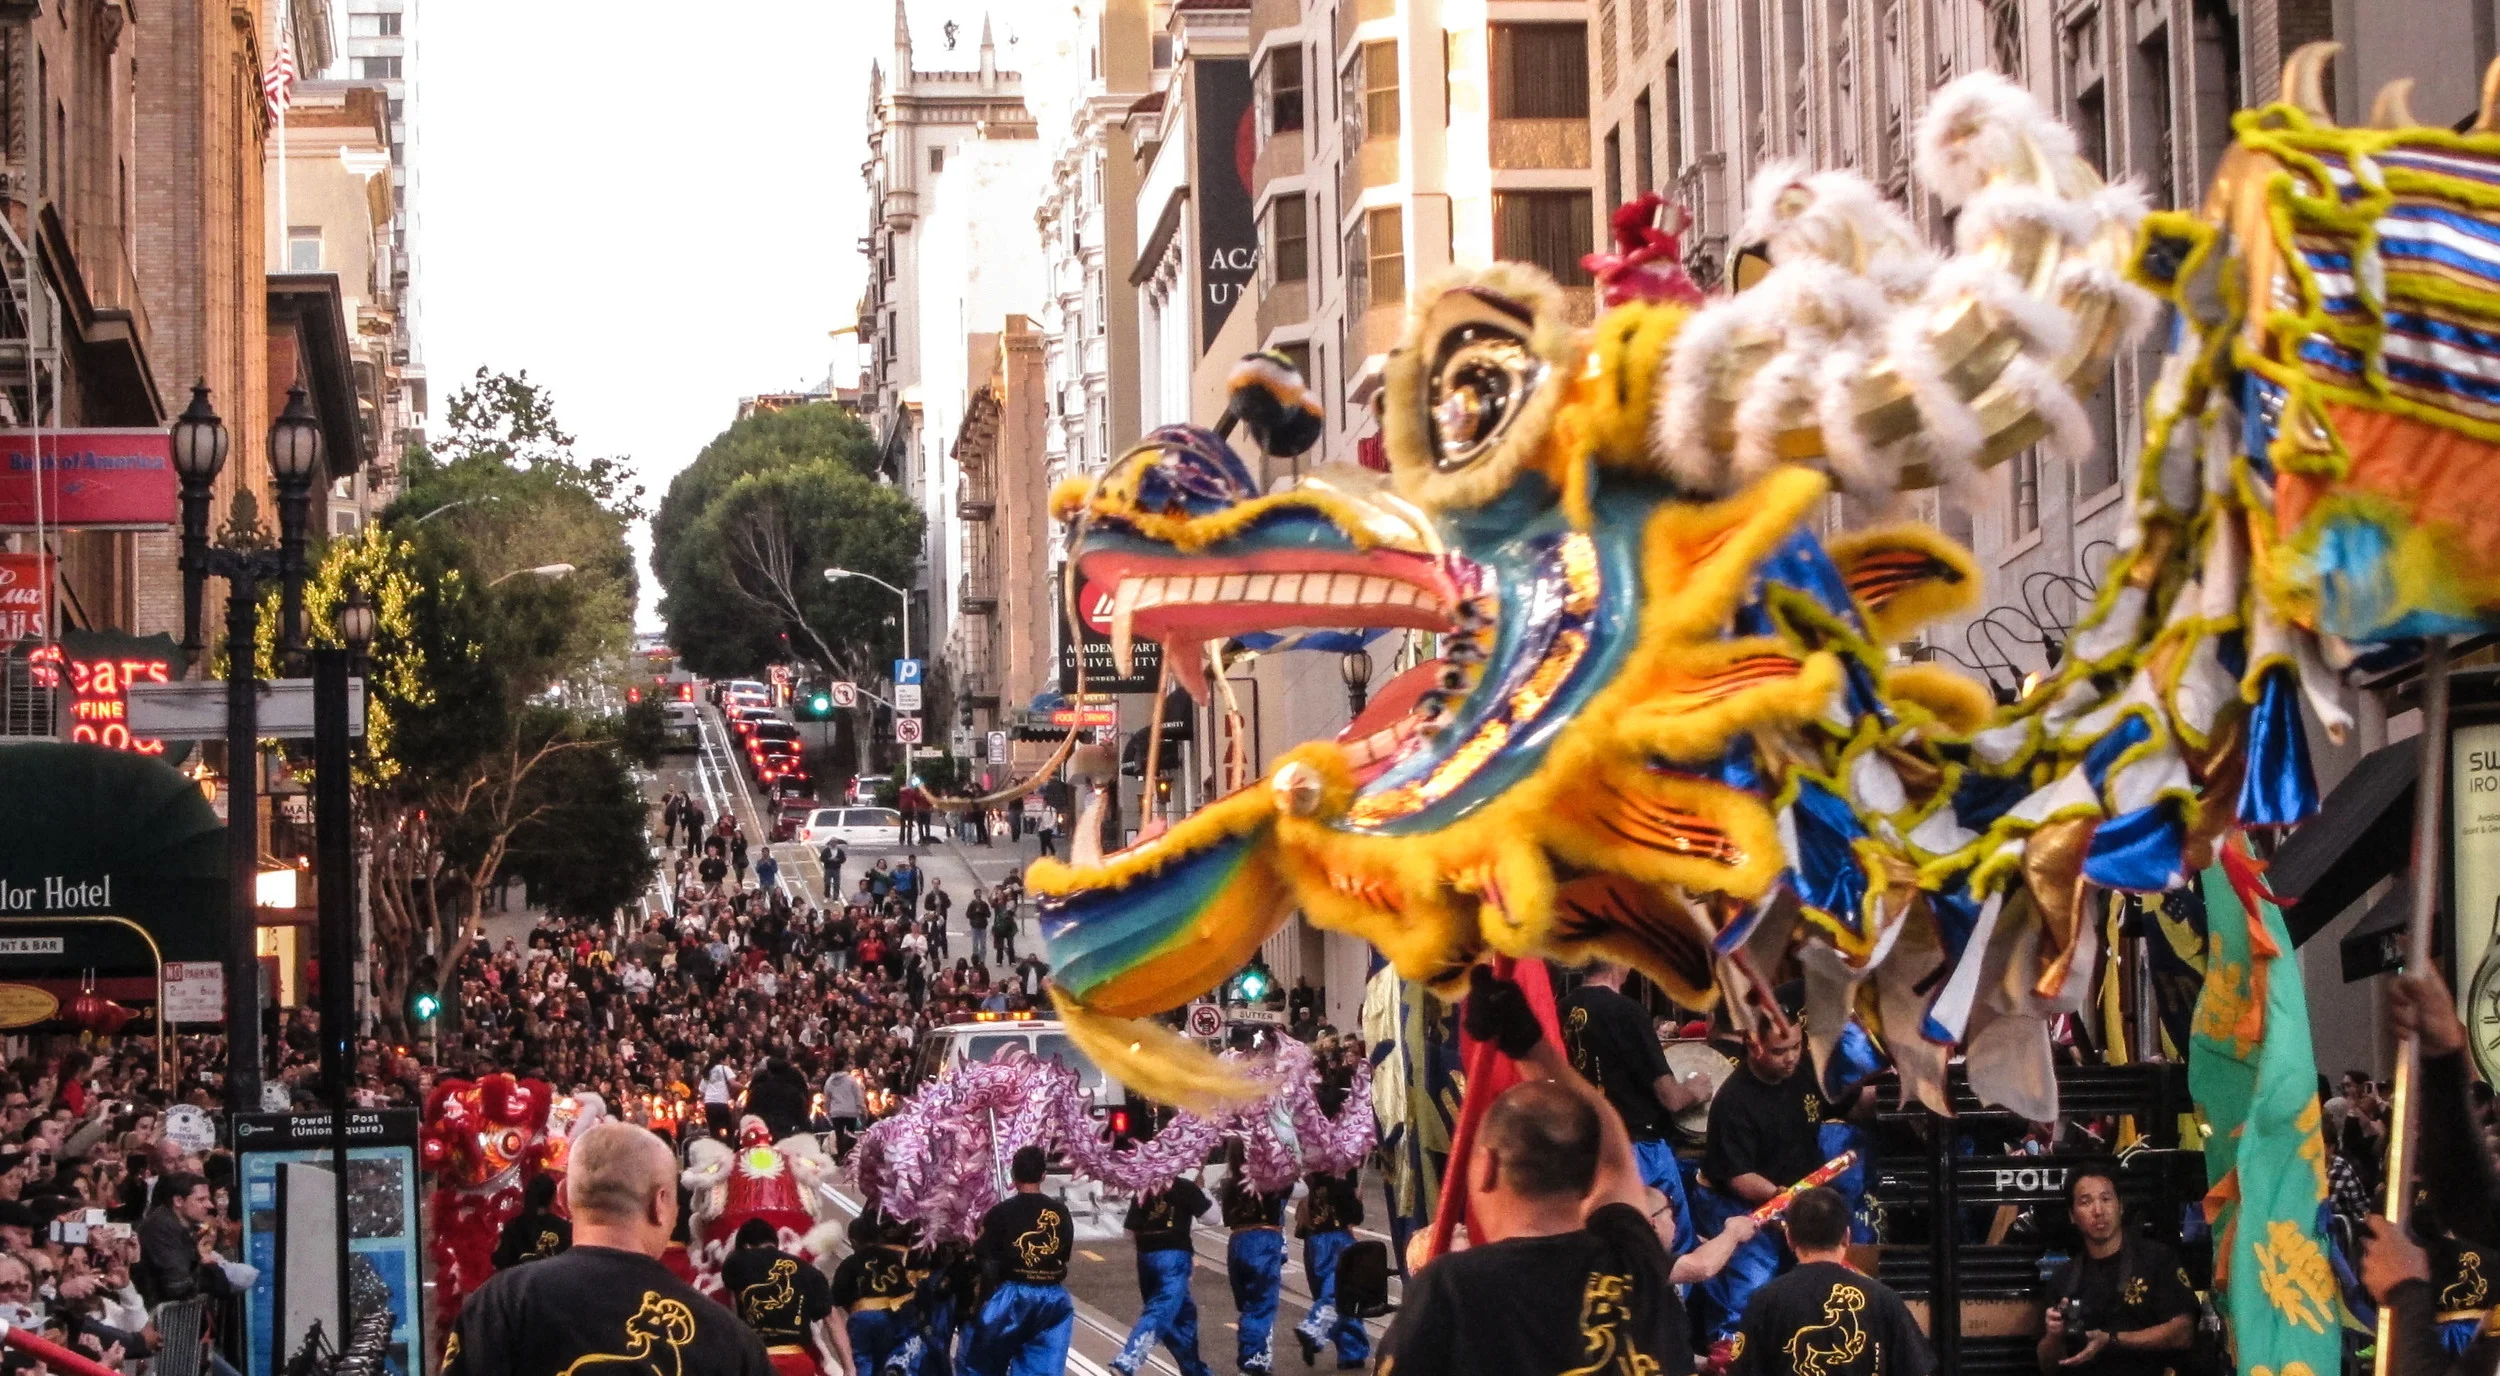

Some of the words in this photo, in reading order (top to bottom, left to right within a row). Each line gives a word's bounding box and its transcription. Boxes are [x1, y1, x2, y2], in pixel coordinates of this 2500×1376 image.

[86, 452, 165, 469] America
[0, 588, 41, 604] ux
[1066, 657, 1158, 668] UIVEITY
[79, 701, 125, 719] FINE
[2470, 776, 2500, 792] IRO
[0, 879, 36, 910] lor
[45, 874, 111, 909] Hotel
[20, 941, 29, 951] &
[32, 940, 57, 950] BAR
[166, 965, 181, 980] NO
[1239, 1010, 1273, 1020] SUTTER
[352, 1114, 379, 1123] Post
[291, 1126, 333, 1137] (Union
[345, 1124, 384, 1135] quare)
